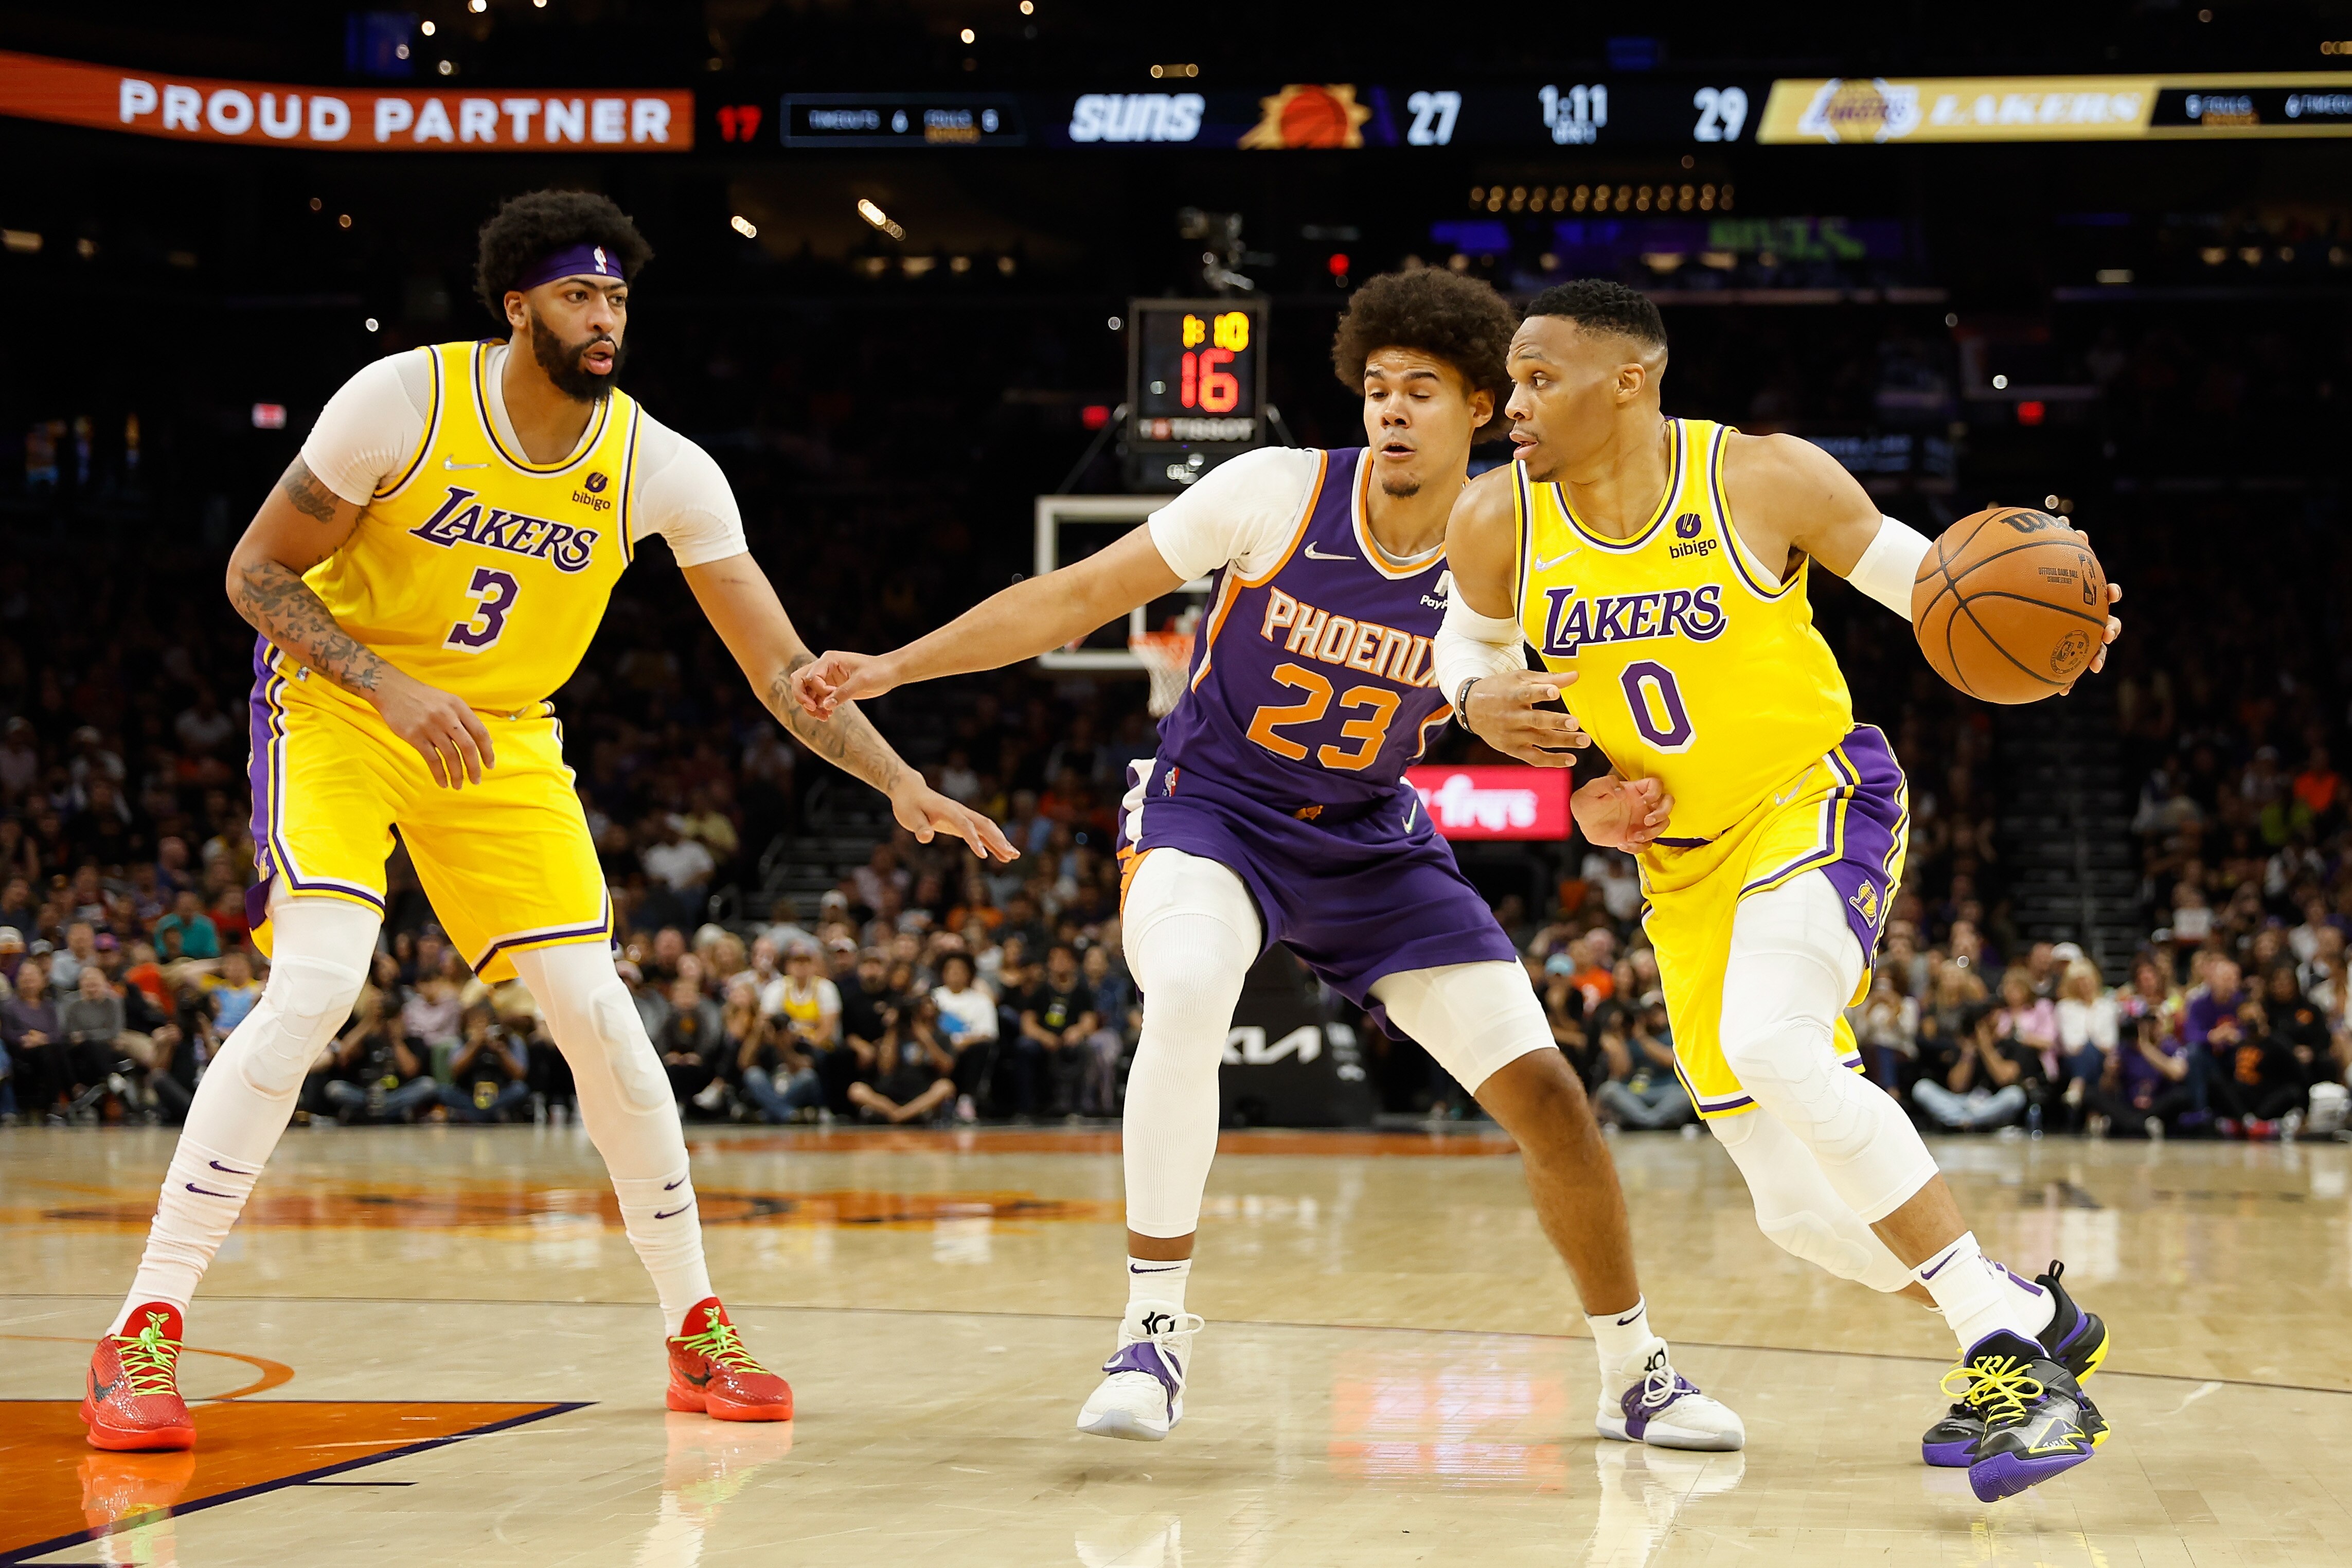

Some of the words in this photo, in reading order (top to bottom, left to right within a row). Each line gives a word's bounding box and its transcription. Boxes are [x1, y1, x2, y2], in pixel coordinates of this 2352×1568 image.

[119, 78, 351, 142] PROUD
[373, 97, 671, 145] PARTNER
[716, 104, 762, 143] 17
[1068, 93, 1205, 142] SUNS
[1407, 91, 1462, 146] 27
[1538, 84, 1608, 128] 1:11
[1694, 86, 1748, 142] 29
[1929, 92, 2144, 127] LAKERS
[1181, 348, 1239, 413] 16
[572, 490, 611, 511] bibigo
[406, 485, 602, 575] LAKERS
[1669, 538, 1717, 559] bibigo
[2038, 567, 2058, 576] OFFICIAL
[2057, 568, 2069, 577] GAME
[442, 565, 521, 655] 3
[1540, 583, 1730, 659] LAKERS
[1246, 662, 1402, 771] 23
[1617, 658, 1698, 755] 0
